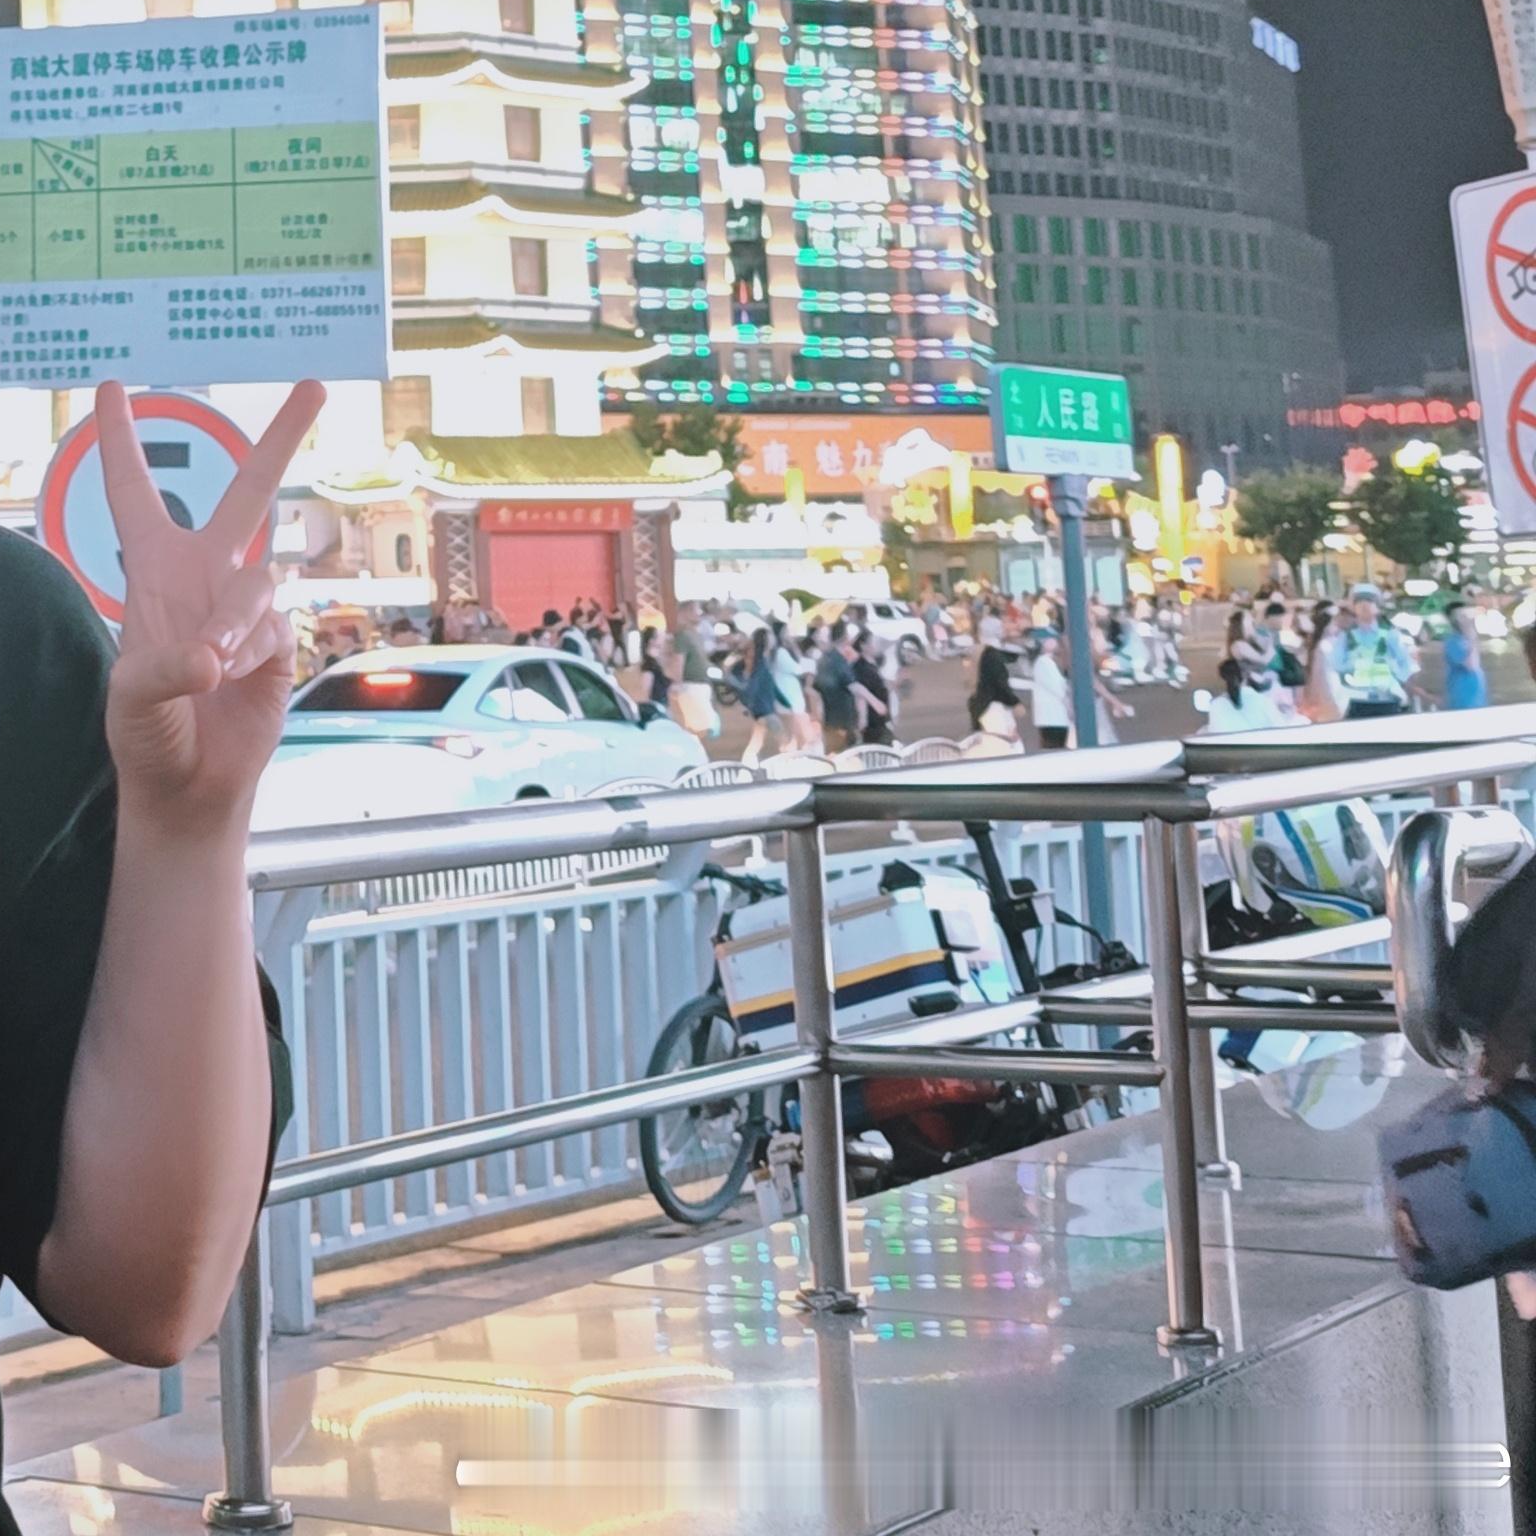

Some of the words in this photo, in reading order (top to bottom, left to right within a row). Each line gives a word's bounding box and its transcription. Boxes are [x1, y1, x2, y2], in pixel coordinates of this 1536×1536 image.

[10, 39, 307, 81] 商城大厦停车场停车收费公示牌
[145, 144, 179, 162] 白天
[287, 136, 322, 155] 夜间
